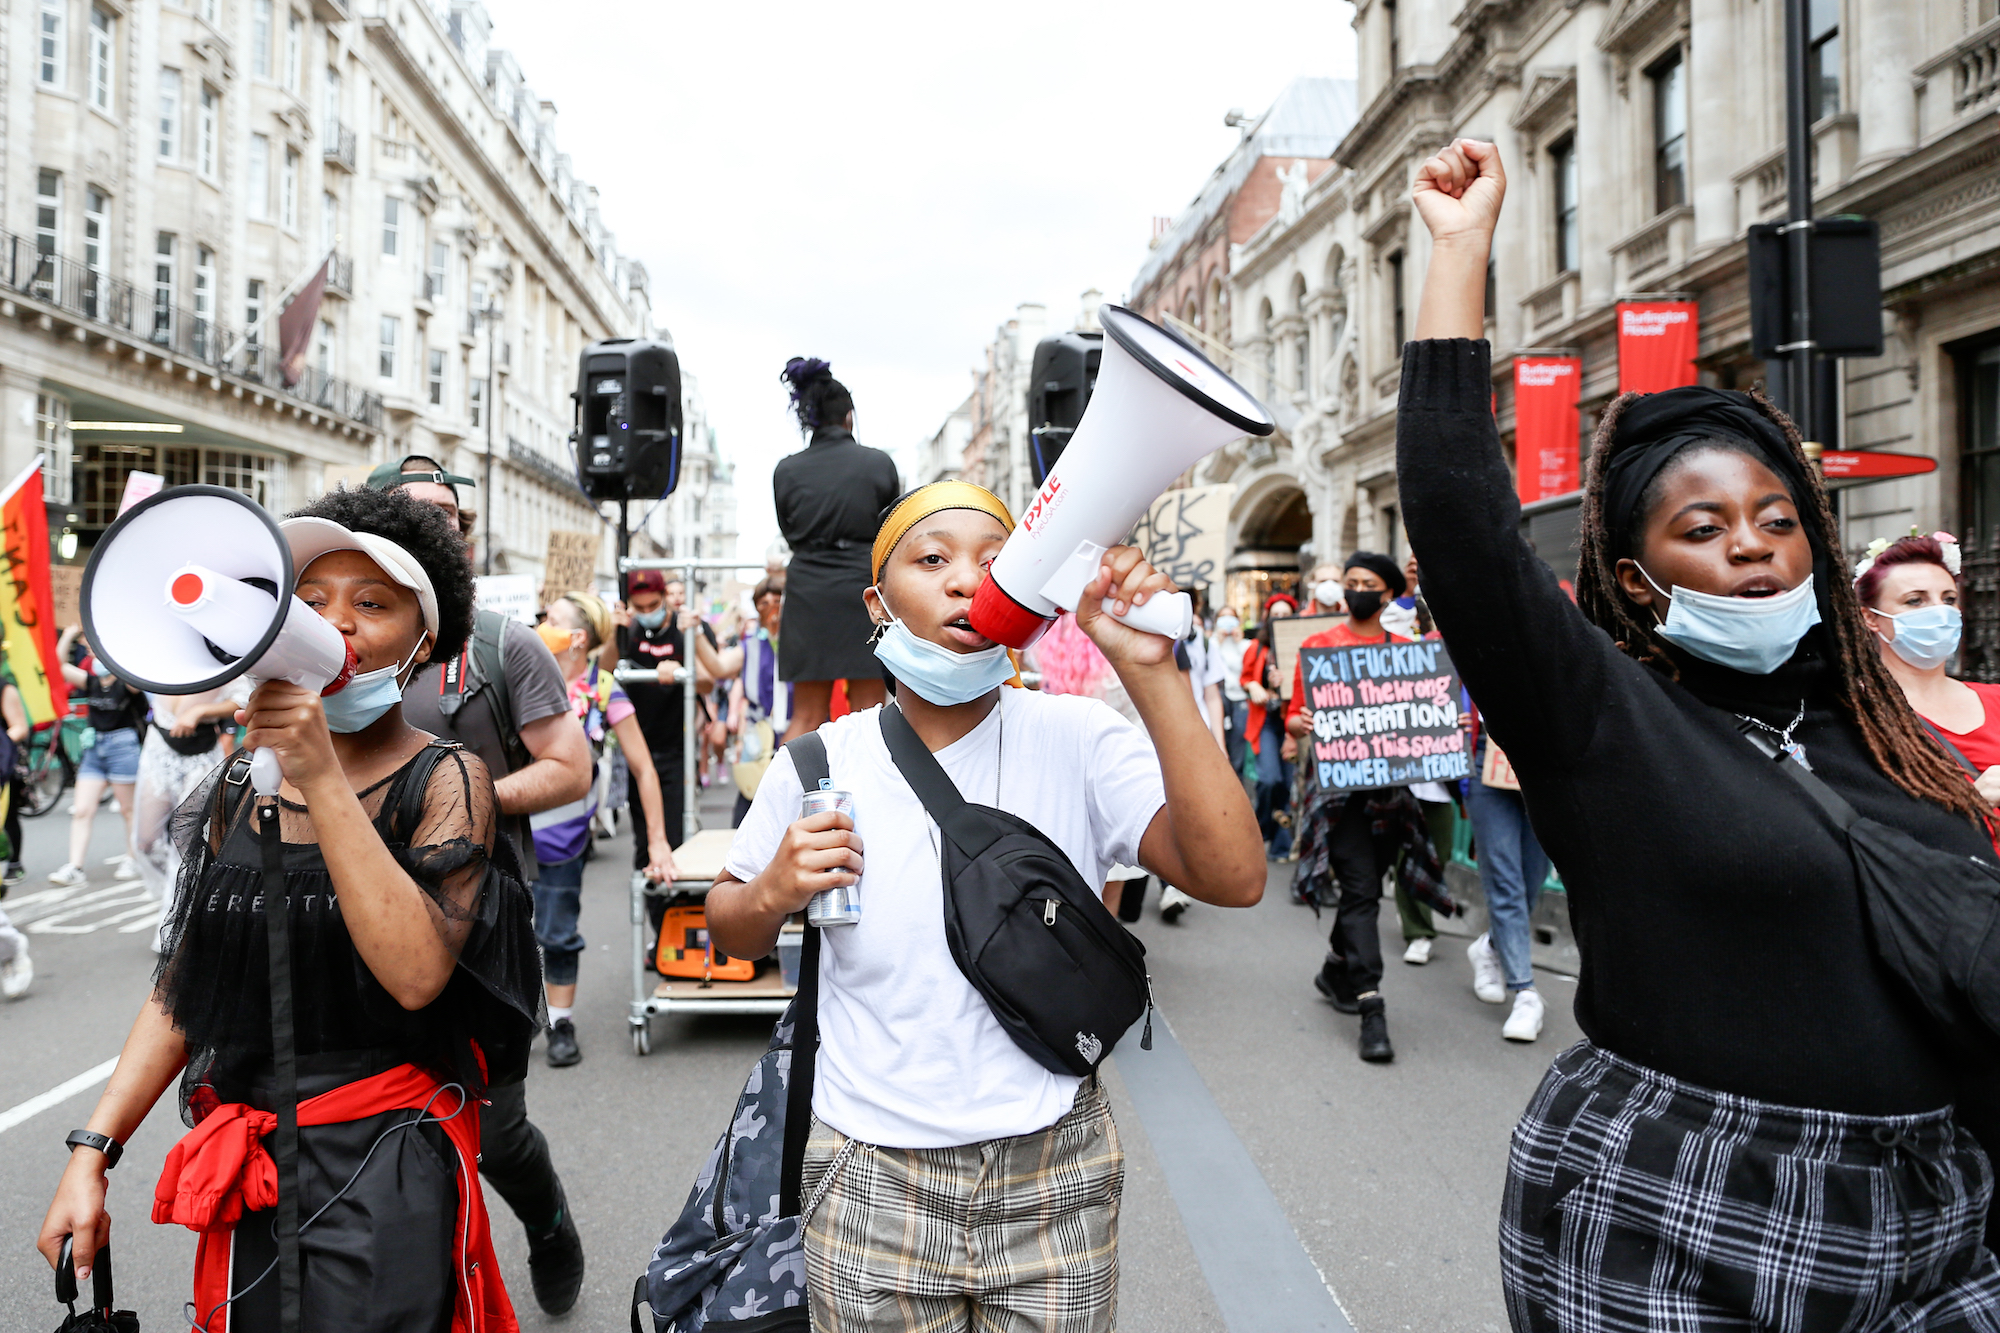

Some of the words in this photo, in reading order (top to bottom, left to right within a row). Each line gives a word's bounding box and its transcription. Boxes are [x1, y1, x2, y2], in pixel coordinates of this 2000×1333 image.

[1623, 310, 1689, 326] Burlington
[1623, 324, 1666, 336] House
[1519, 363, 1574, 377] Burlington
[1519, 374, 1555, 386] House
[1023, 474, 1061, 532] PYLE
[1031, 488, 1069, 540] PyleUSA.com
[1357, 678, 1394, 705] the
[1313, 700, 1459, 742] GENERATION!
[1318, 758, 1391, 788] POWER
[1422, 751, 1470, 781] PEOPLE
